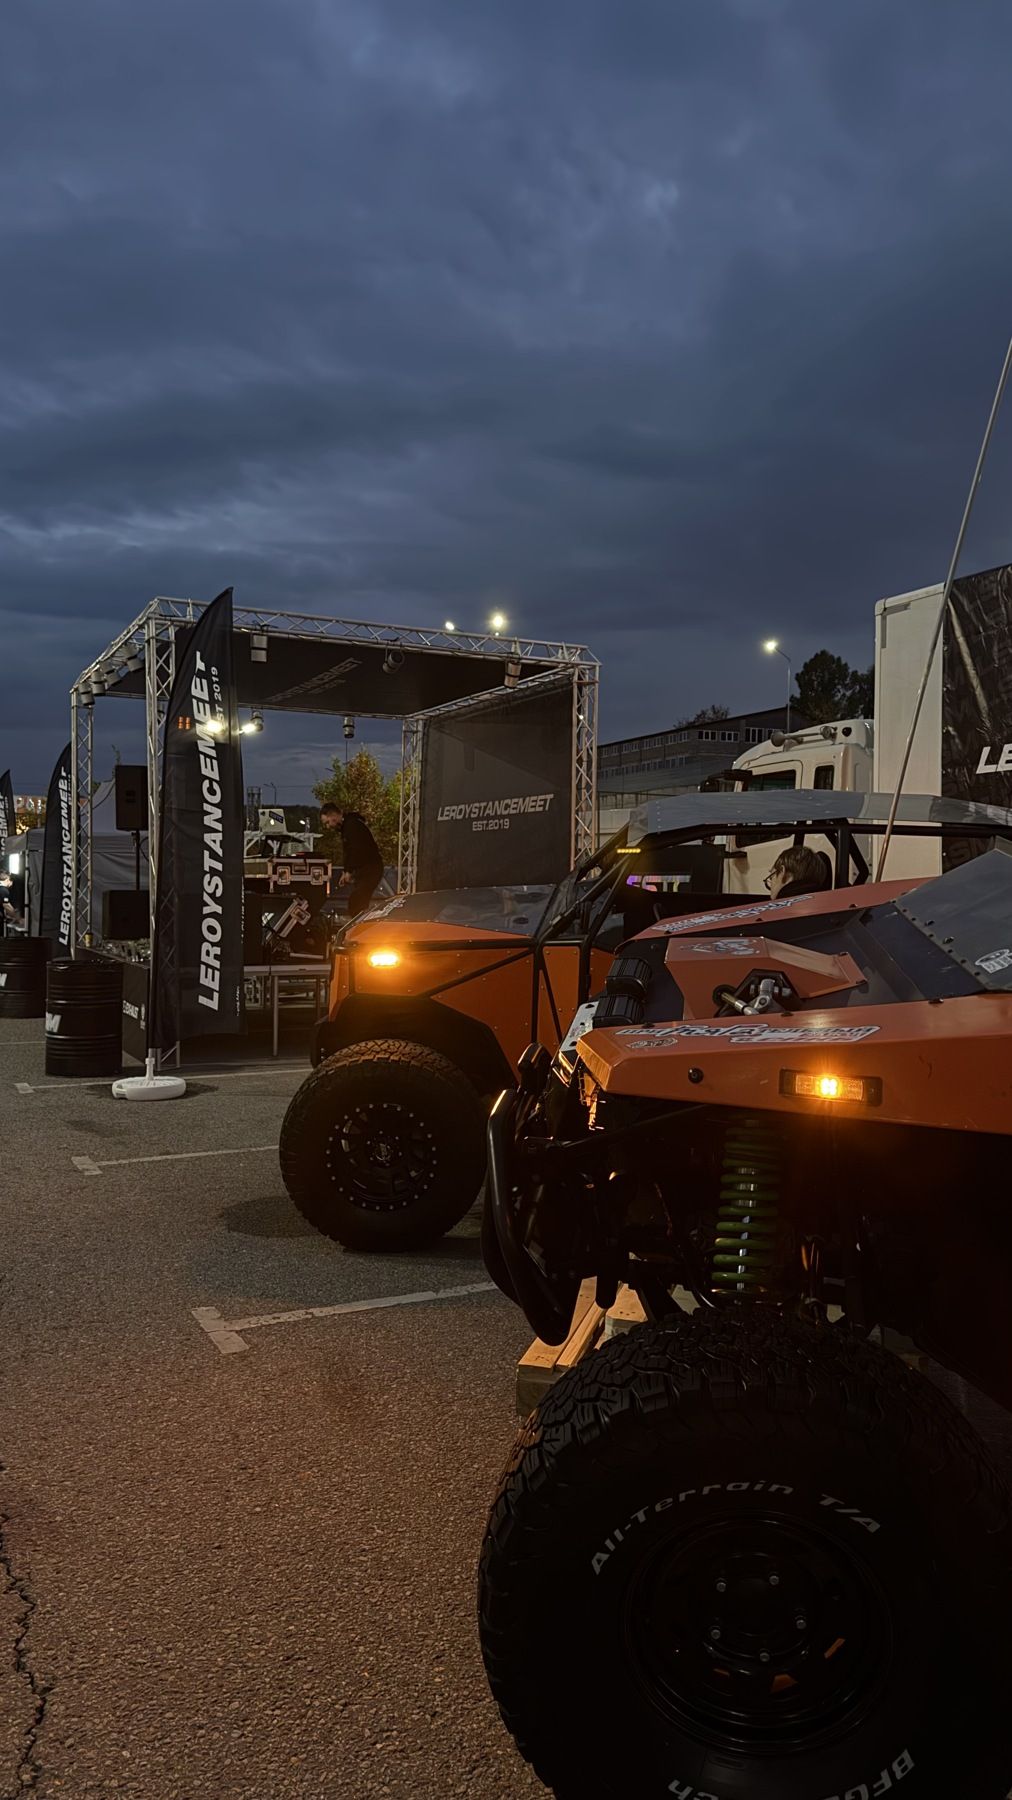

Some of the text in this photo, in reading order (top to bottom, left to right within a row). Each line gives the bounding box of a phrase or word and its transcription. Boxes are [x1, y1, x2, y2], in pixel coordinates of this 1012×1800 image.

[211, 666, 222, 701] 2019
[437, 793, 554, 822] LEROYSTANCEMEET
[472, 818, 510, 832] EST.2019
[190, 650, 224, 1011] LEROYSTANCEMEET
[590, 1479, 882, 1576] All-Terrain T/A
